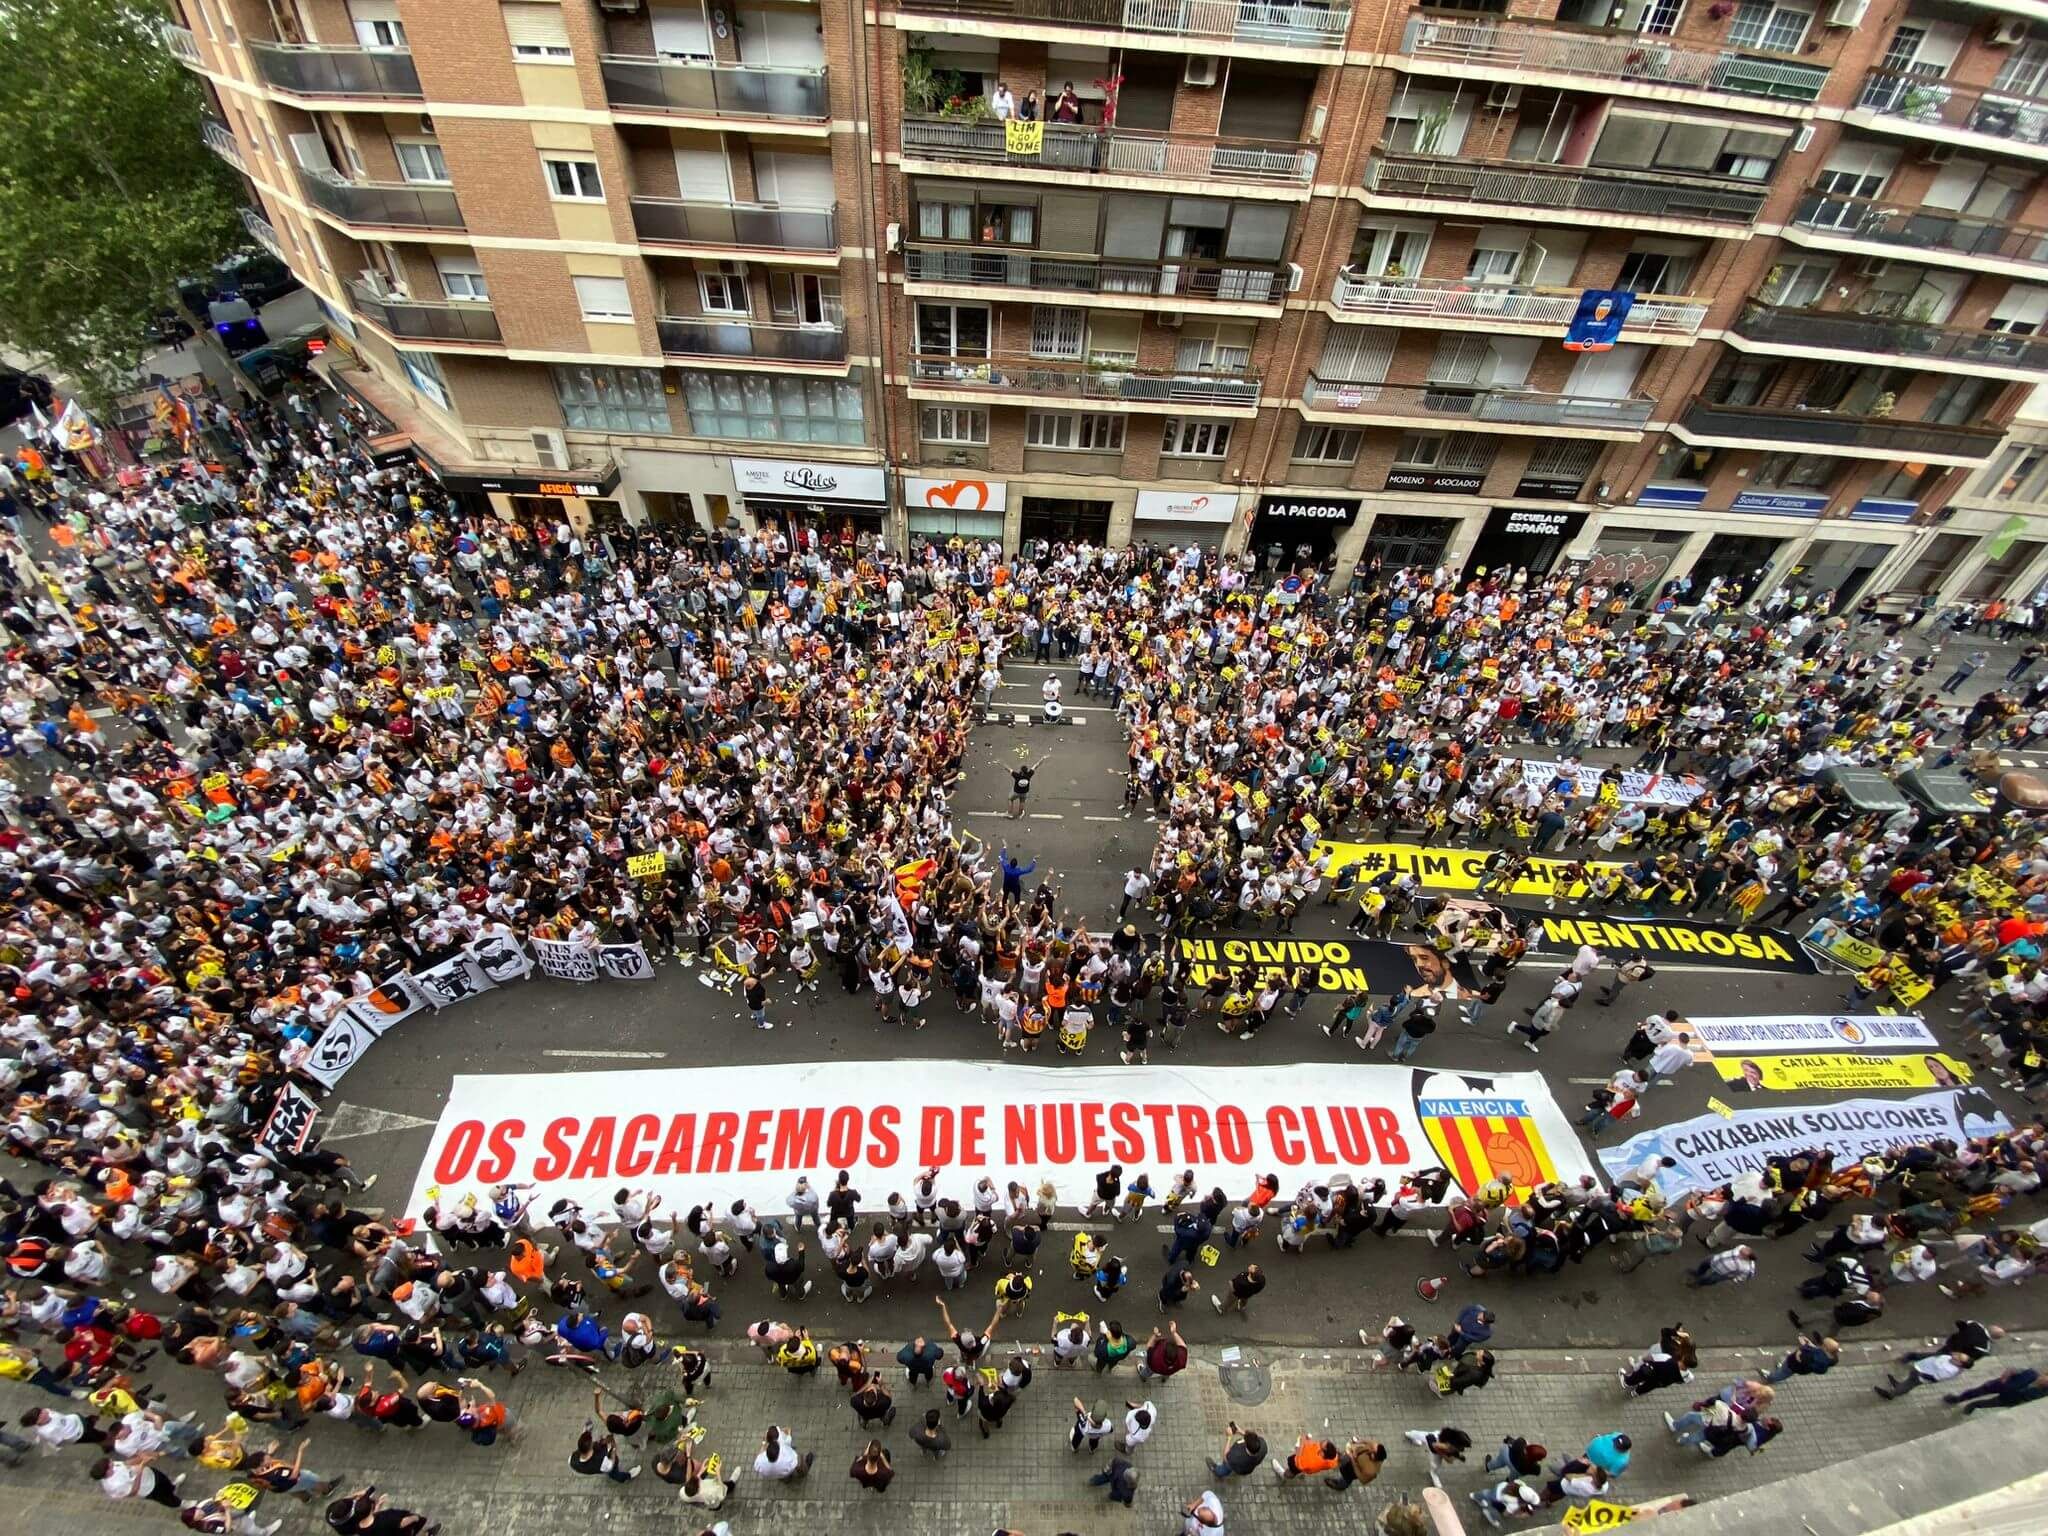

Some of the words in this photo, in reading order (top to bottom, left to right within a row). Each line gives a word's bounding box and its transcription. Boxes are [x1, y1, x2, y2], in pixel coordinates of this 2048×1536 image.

[1013, 122, 1035, 132] LIM
[1008, 140, 1040, 151] HOME
[798, 468, 837, 489] Palco
[1389, 475, 1425, 485] MORENO
[1434, 478, 1480, 488] ASOCIADOS
[576, 485, 600, 496] BAR
[1738, 496, 1770, 505] Solmar
[1268, 504, 1286, 516] LA
[1289, 505, 1347, 518] PAGODA
[1510, 513, 1552, 523] ESCUELA
[1553, 515, 1568, 524] DE
[1505, 522, 1560, 535] ESPAÑOL
[636, 853, 656, 863] LIM
[1363, 852, 1452, 877] #LIM
[632, 864, 663, 876] HOME
[1543, 917, 1794, 962] MENTIROSA
[544, 944, 570, 954] TUS
[1181, 939, 1217, 961] NI
[1223, 941, 1351, 964] OLVIDO
[1850, 942, 1873, 956] NO
[1895, 964, 1925, 989] LIM
[1697, 1025, 1751, 1041] LUCHAMOS
[1745, 1025, 1771, 1041] POR
[1764, 1024, 1810, 1040] NUESTRO
[1804, 1023, 1834, 1039] CLUB
[1864, 1023, 1888, 1037] LIM
[1833, 1057, 1842, 1065] Y
[1845, 1079, 1870, 1087] CASA
[1870, 1079, 1911, 1087] NOSTRA
[1424, 1101, 1518, 1115] VALENCIA
[1675, 1116, 1804, 1159] CAIXABANK
[1802, 1107, 1949, 1133] SOLUCIONES
[434, 1119, 526, 1185] OS
[533, 1105, 900, 1182] SACAREMOS
[919, 1105, 986, 1167] DE
[1004, 1102, 1254, 1165] NUESTRO
[1266, 1105, 1411, 1165] CLUB
[1702, 1161, 1732, 1182] EL
